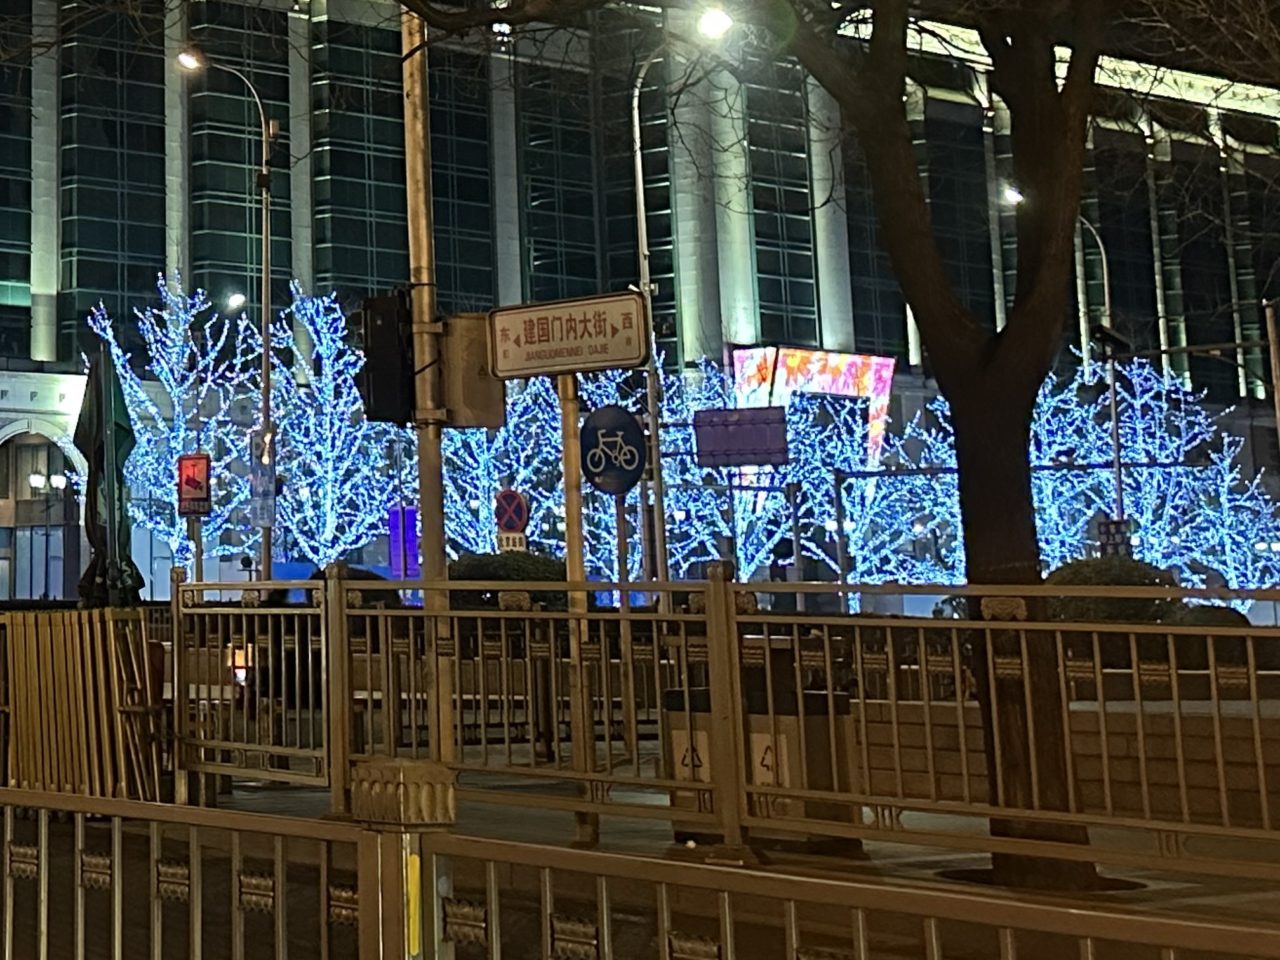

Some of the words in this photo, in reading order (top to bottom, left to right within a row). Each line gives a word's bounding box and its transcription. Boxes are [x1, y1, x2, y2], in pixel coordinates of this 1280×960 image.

[523, 311, 607, 344] 建国门内大街
[621, 312, 633, 330] 西
[500, 327, 511, 343] 东
[588, 343, 609, 356] DAJIE
